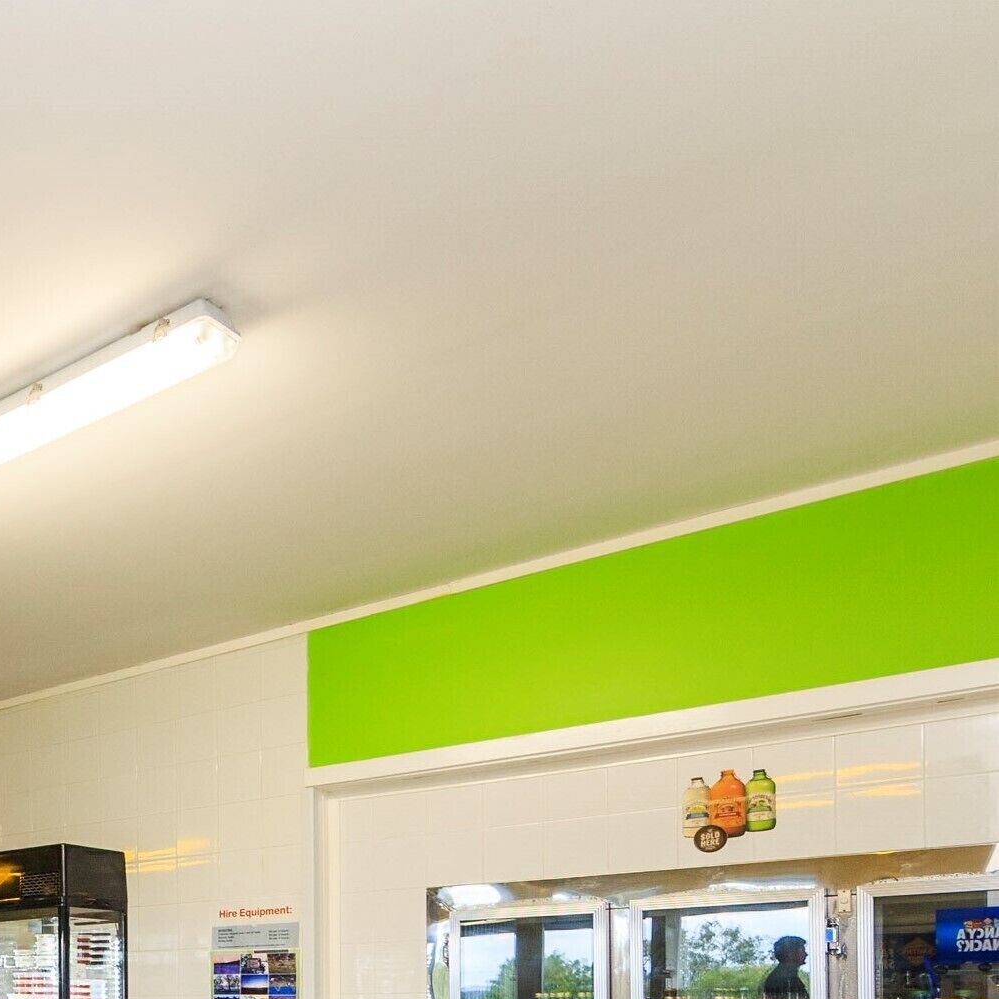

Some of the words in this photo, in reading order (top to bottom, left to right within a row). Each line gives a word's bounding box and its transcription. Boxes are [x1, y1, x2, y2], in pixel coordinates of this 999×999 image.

[700, 831, 720, 840] SOLD
[700, 839, 720, 848] HERE
[218, 909, 238, 919] Hire
[239, 905, 293, 918] Equipment:
